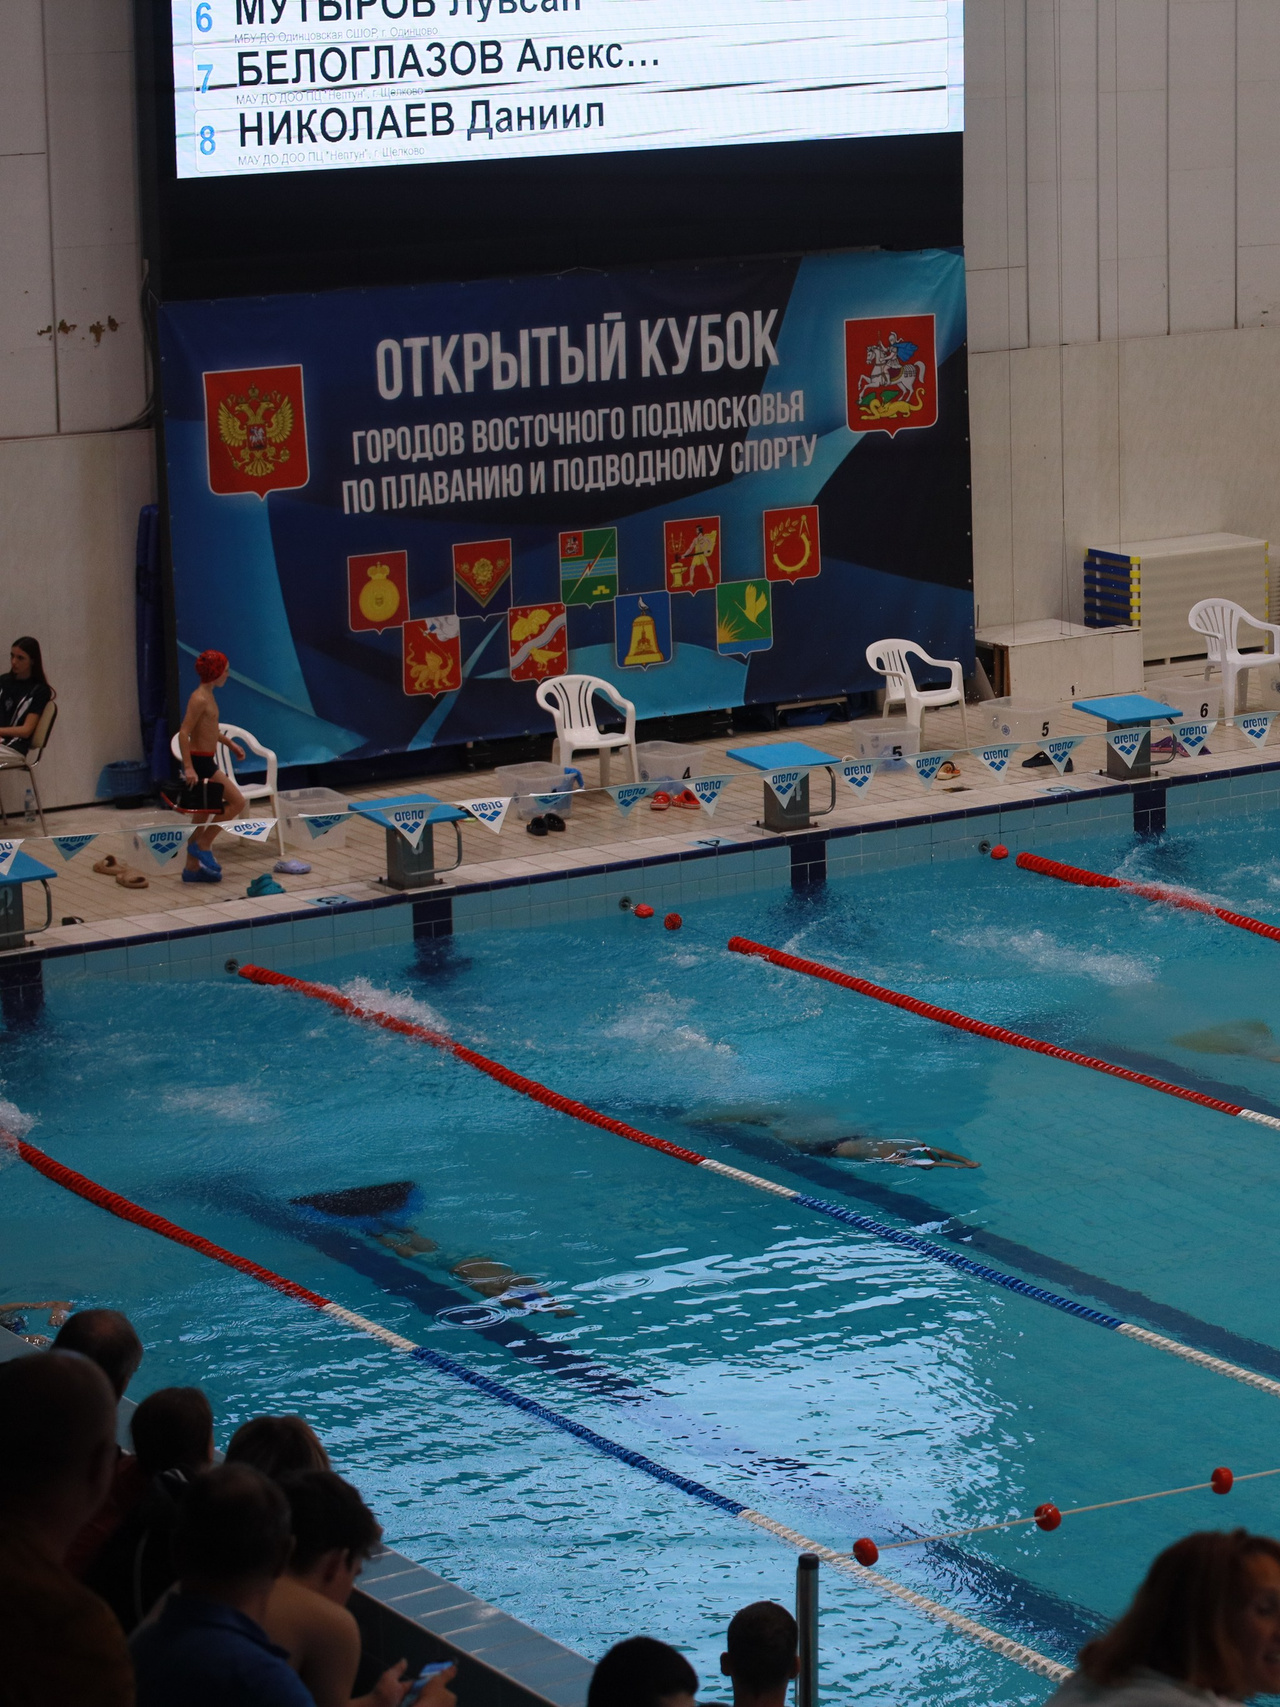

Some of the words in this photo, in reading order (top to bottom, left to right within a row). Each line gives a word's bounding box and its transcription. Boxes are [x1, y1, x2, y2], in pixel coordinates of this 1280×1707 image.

[195, 2, 213, 32] 6
[197, 64, 214, 94] 7
[237, 40, 504, 86] БЕЛОГЛАЗОВ
[199, 126, 216, 155] 8
[239, 102, 454, 147] НИКОЛАЕВ
[467, 100, 604, 141] Даниил
[238, 155, 260, 165] МАУ
[263, 154, 279, 166] ДО
[281, 153, 306, 166] ДОО
[375, 312, 627, 400] ОТКРЫТЫЙ
[640, 308, 780, 378] КУБОК
[352, 421, 465, 466] ГОРОДОВ
[472, 407, 625, 454] ВОСТОЧНОГО
[631, 390, 805, 440] ПОДМОСКОВЬЯ
[342, 478, 375, 515] ПО
[382, 463, 524, 511] ПЛАВАНИЮ
[529, 461, 547, 495] И
[553, 443, 724, 493] ПОДВОДНОМУ
[730, 434, 818, 477] СПОРТУ
[1200, 702, 1209, 718] 6
[1041, 721, 1050, 737] 5
[1242, 717, 1268, 729] arena
[1179, 725, 1208, 737] arena
[1113, 733, 1140, 745] arena
[892, 745, 903, 761] 5
[1048, 741, 1074, 753] arena
[983, 748, 1009, 761] arena
[916, 756, 941, 769] arena
[843, 764, 872, 776] arena
[772, 772, 798, 785] arena
[694, 780, 722, 792] arena
[618, 787, 647, 800] arena
[471, 800, 504, 812] arena
[394, 809, 425, 822] arena
[150, 831, 183, 843] arena
